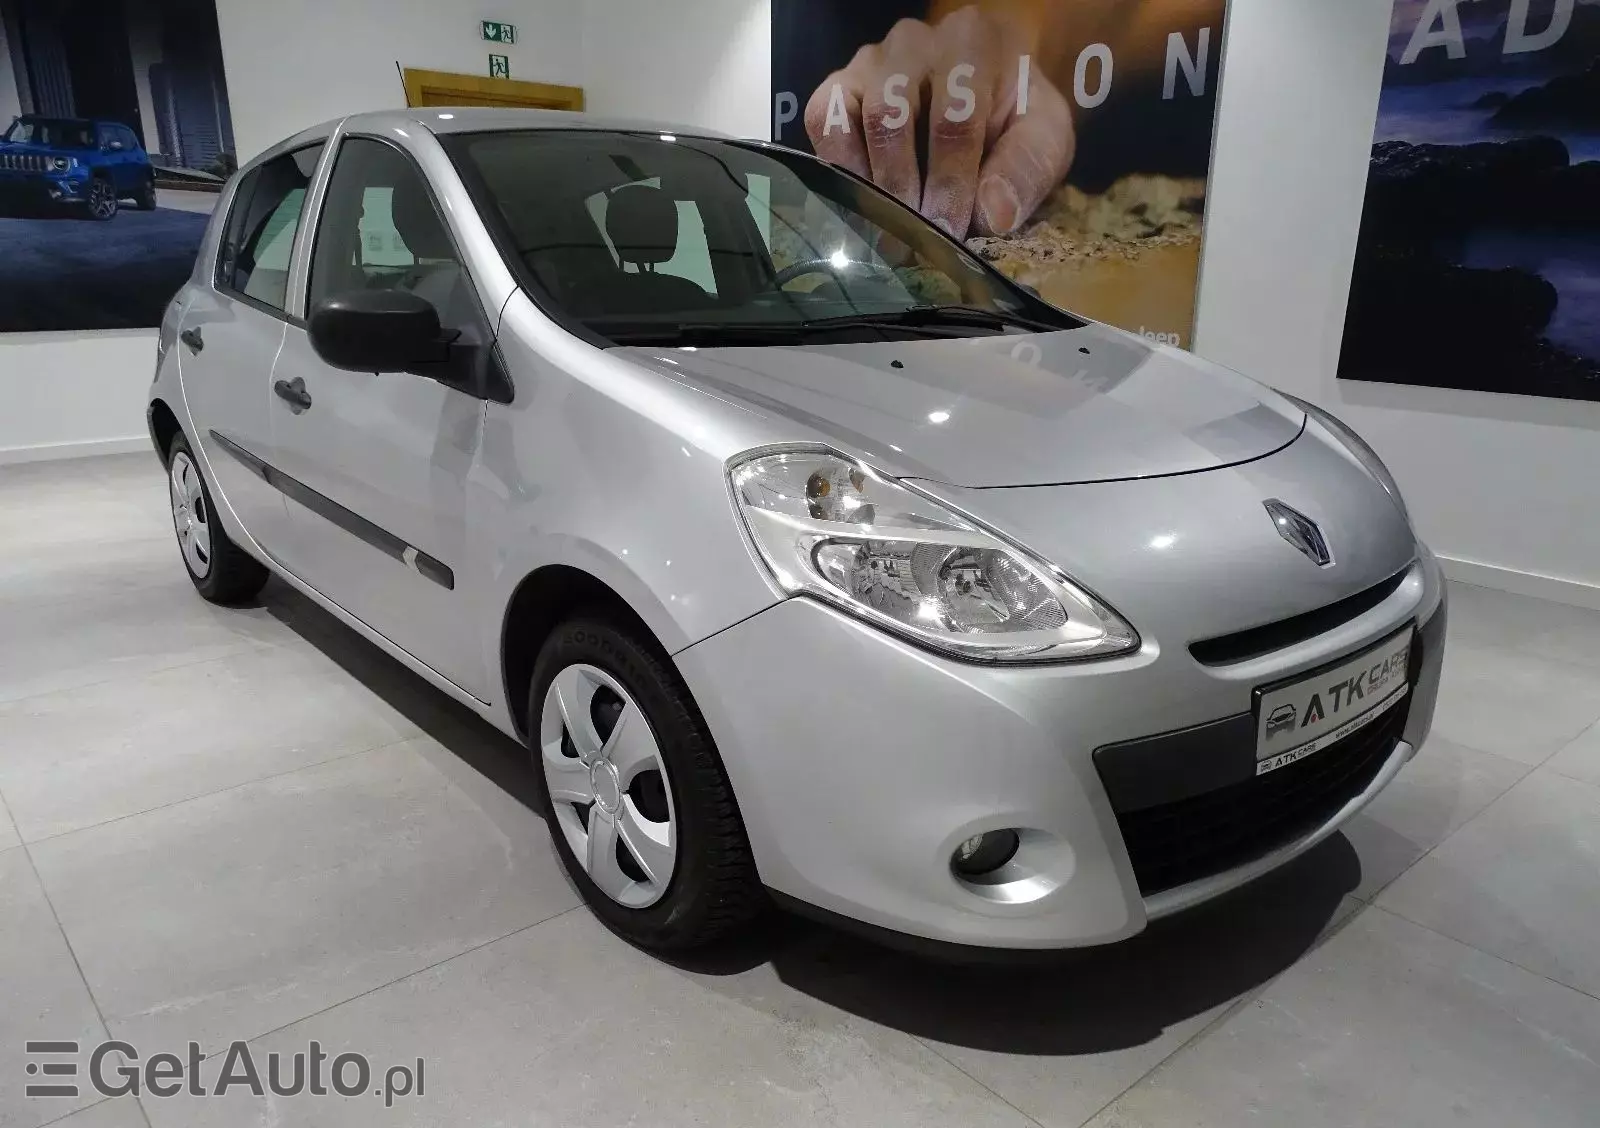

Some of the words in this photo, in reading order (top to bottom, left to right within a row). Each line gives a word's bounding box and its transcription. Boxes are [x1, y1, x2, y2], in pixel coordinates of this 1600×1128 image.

[774, 27, 1210, 141] PASSION
[1301, 670, 1367, 728] ATK
[1275, 751, 1297, 767] ATK
